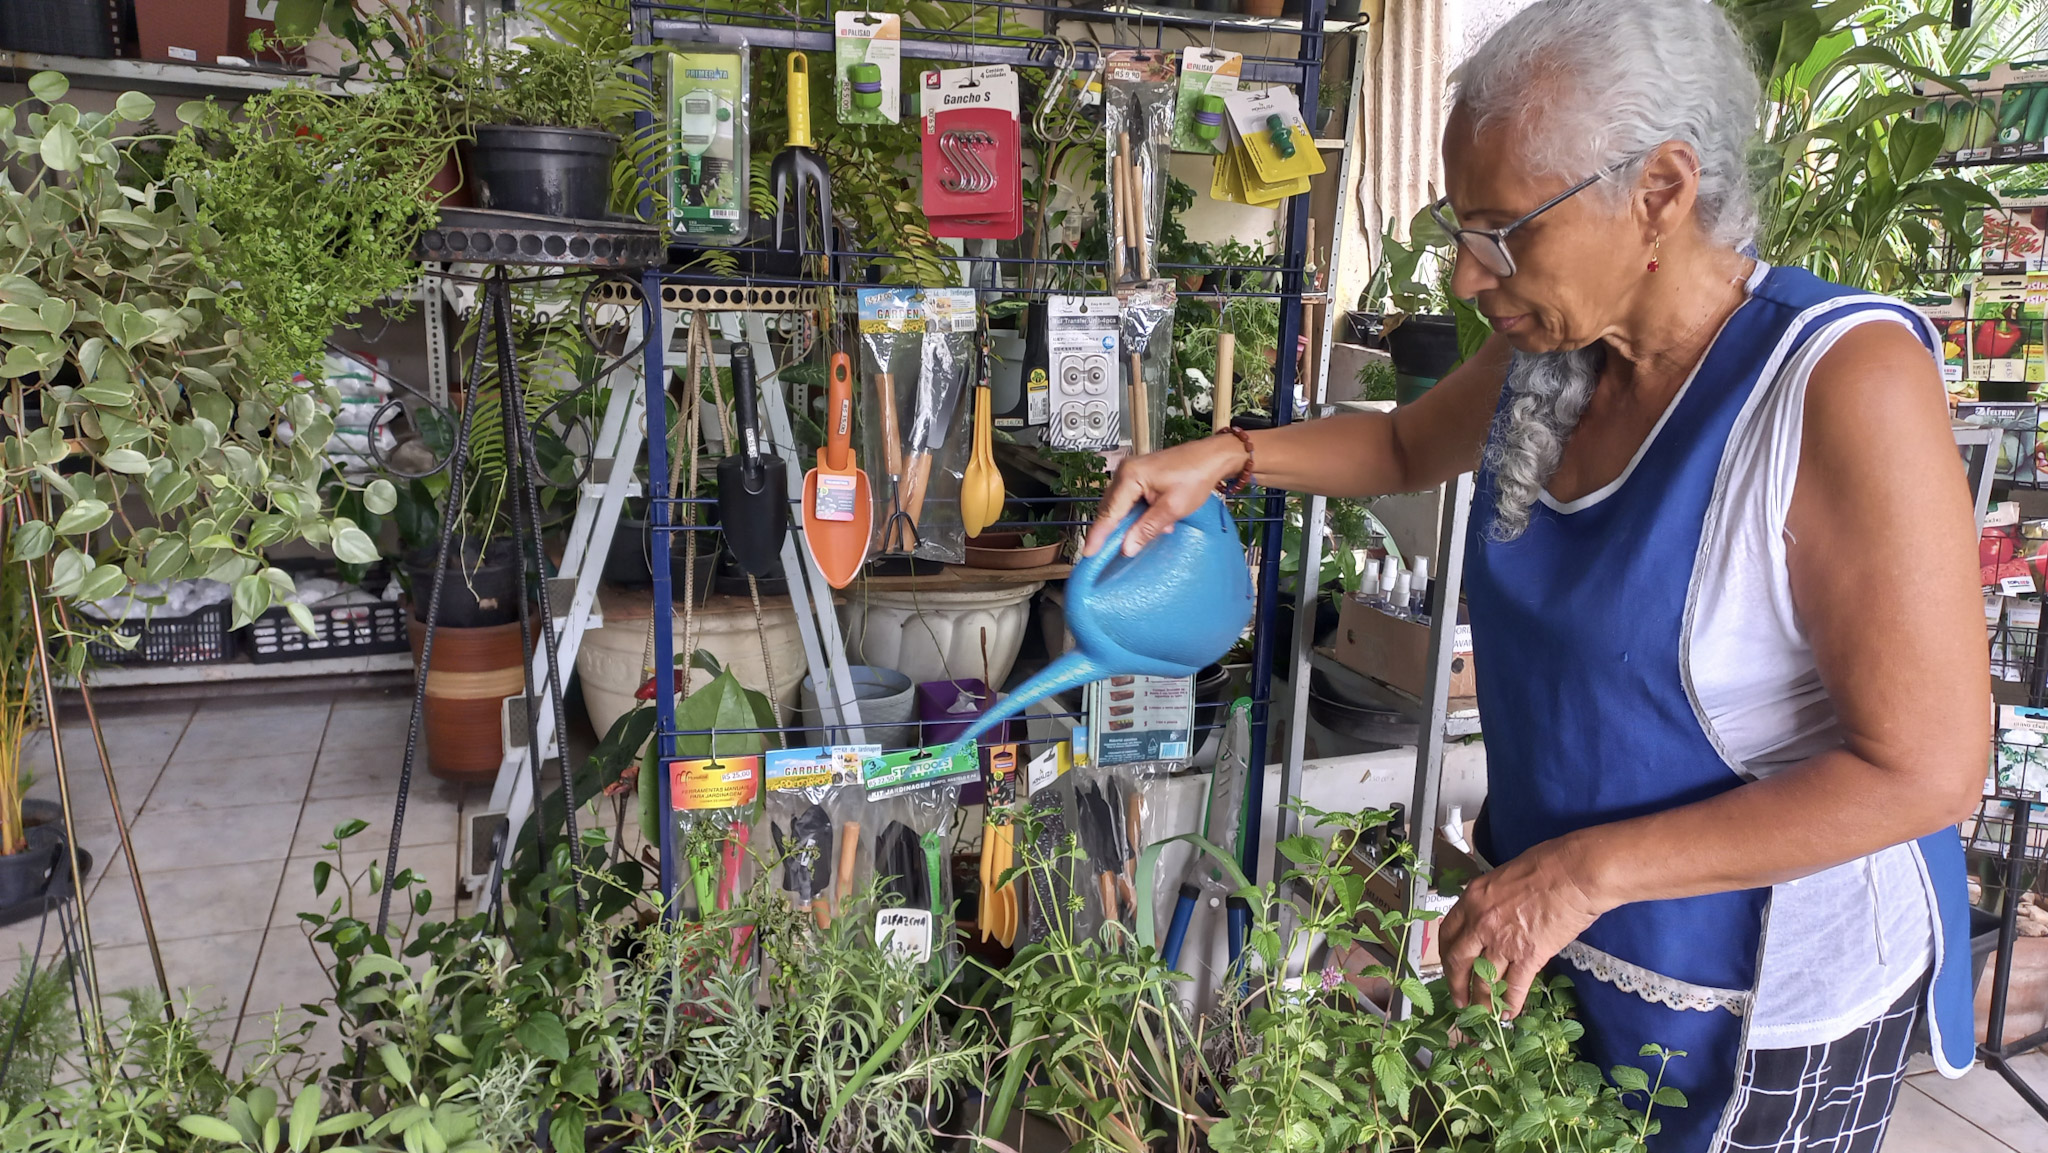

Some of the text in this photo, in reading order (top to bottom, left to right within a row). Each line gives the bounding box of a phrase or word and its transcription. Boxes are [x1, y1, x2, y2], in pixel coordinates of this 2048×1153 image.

[848, 29, 871, 37] PALISAD
[1192, 63, 1214, 72] PALISAD
[943, 91, 991, 105] Gancho S
[929, 125, 935, 134] R$
[877, 309, 920, 320] GARDEN
[784, 764, 827, 777] GARDEN
[868, 760, 877, 771] 3
[732, 770, 751, 779] 25,00
[871, 790, 884, 799] KIT
[885, 781, 931, 796] JARDINAGEM
